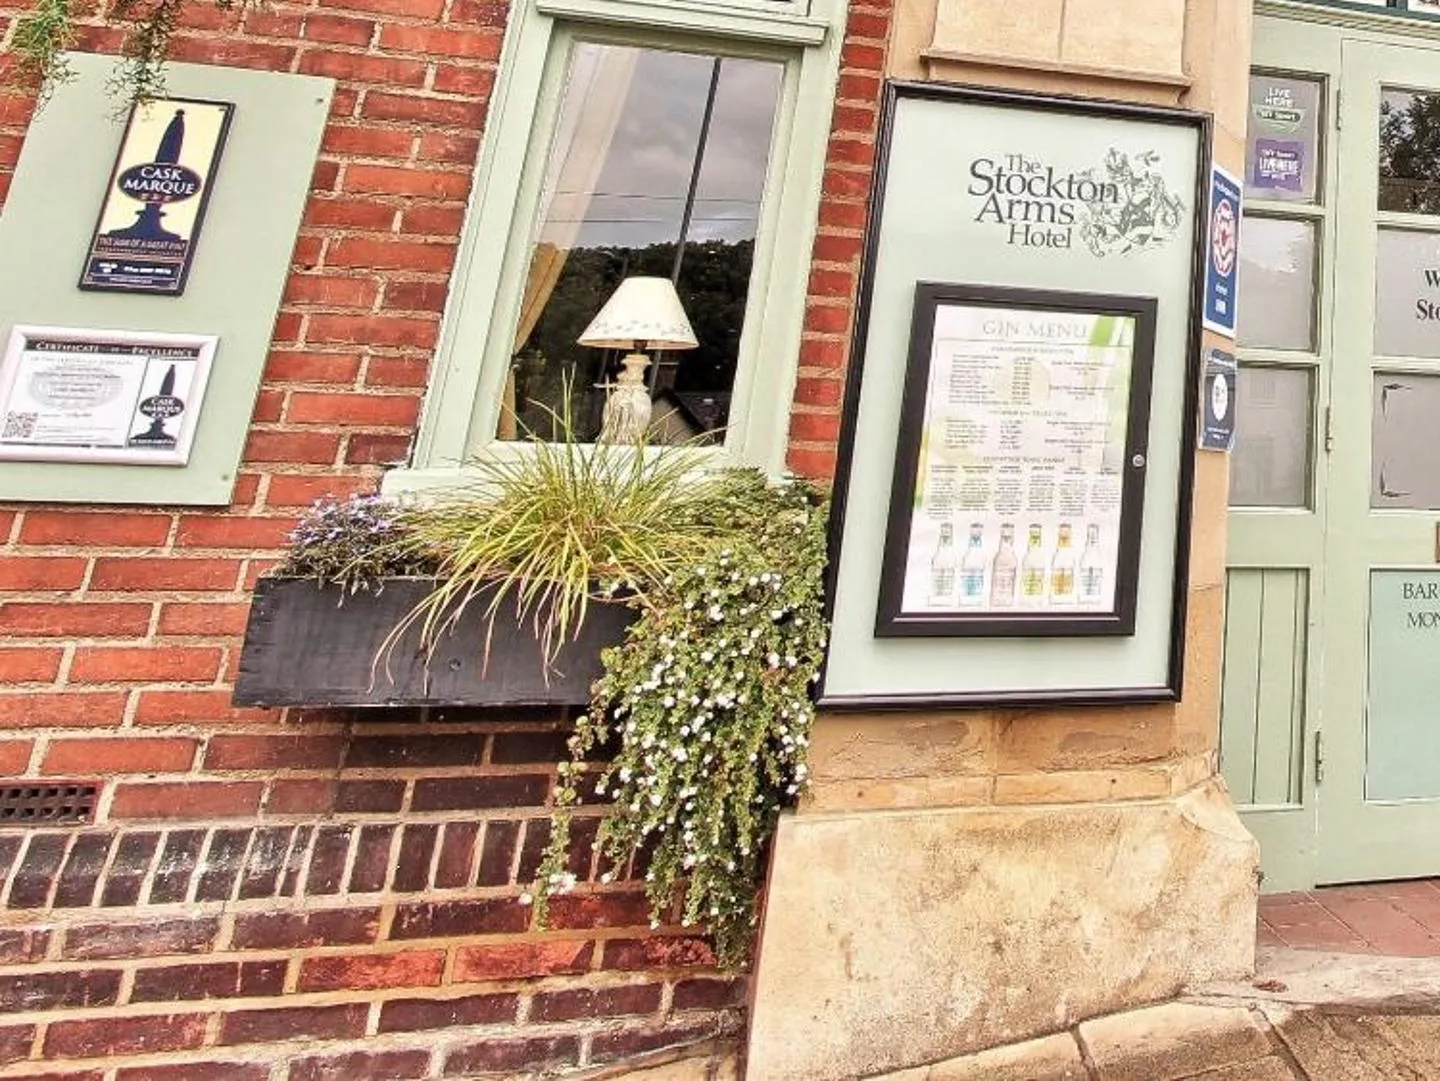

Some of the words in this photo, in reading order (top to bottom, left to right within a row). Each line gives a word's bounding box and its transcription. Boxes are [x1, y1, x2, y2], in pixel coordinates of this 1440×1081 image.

[1269, 87, 1291, 98] LIVE
[141, 167, 182, 180] CASK
[1004, 154, 1041, 175] The
[124, 179, 195, 194] MARQUE
[968, 158, 1120, 204] Stockton
[974, 191, 1076, 225] Arms
[1006, 223, 1073, 249] Hotel
[982, 320, 1019, 337] GIN
[1026, 322, 1087, 338] MENU
[1403, 583, 1438, 600] BAR
